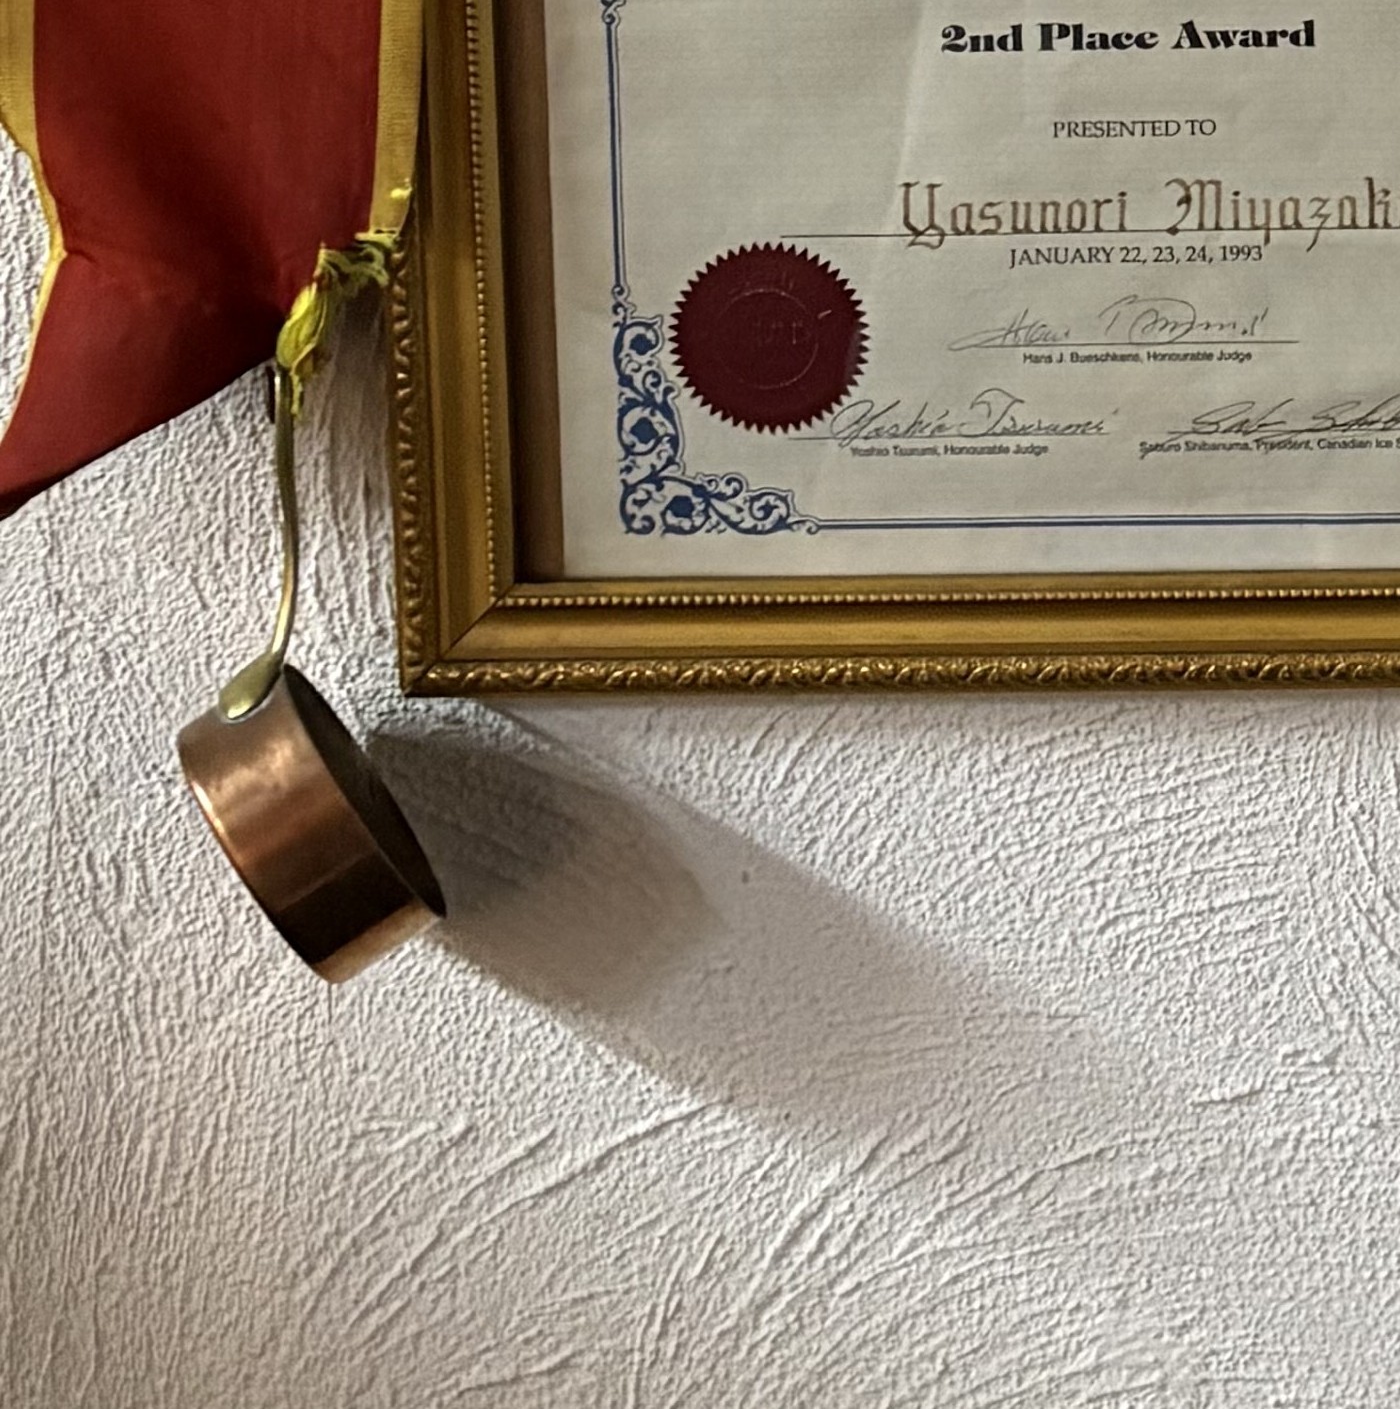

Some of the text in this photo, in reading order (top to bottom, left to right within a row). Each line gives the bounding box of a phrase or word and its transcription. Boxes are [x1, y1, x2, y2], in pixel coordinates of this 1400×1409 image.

[940, 18, 1317, 56] 2nd Place Award
[1053, 118, 1217, 139] PRESENTED TO
[899, 180, 1129, 250] Yasunori
[1008, 244, 1264, 269] JANUARY 22, 23, 24, 1993
[1022, 351, 1053, 364] Hans
[1146, 351, 1213, 363] Honourable
[1217, 350, 1253, 364] Judge
[943, 444, 1011, 456] Honourable
[1013, 443, 1049, 457] Judge
[1317, 437, 1373, 450] Canadian
[1375, 437, 1394, 449] Ice
